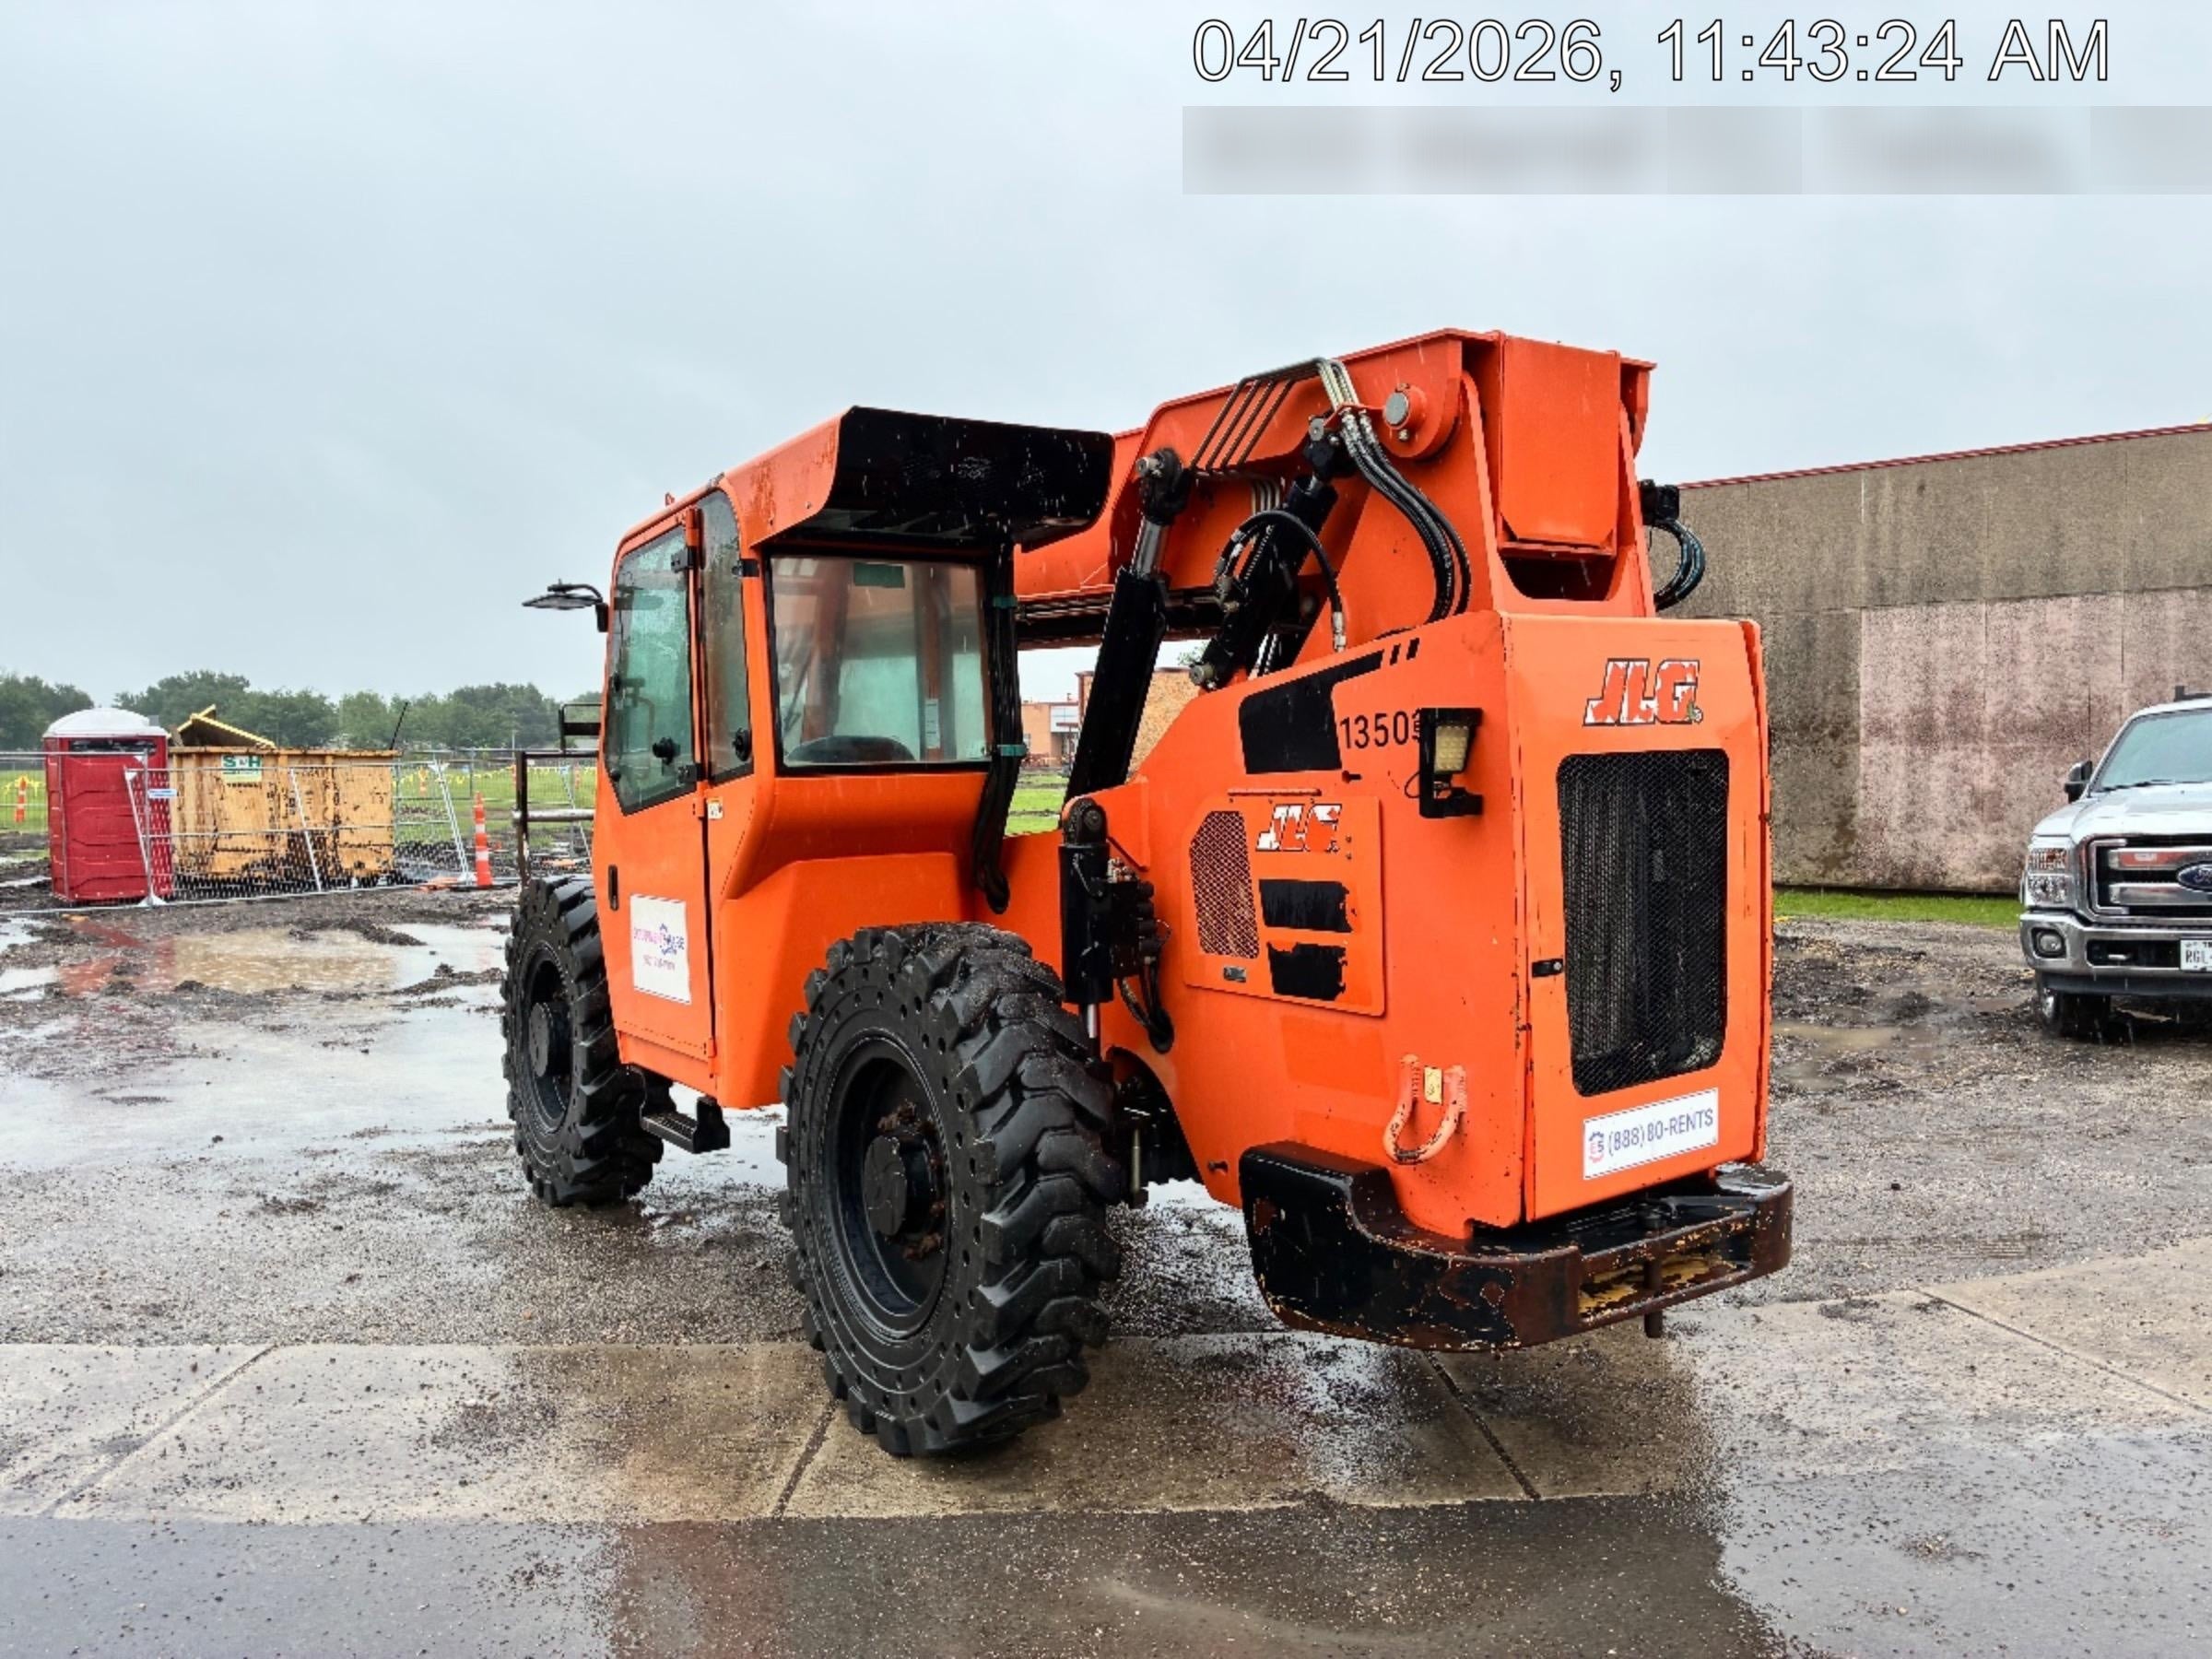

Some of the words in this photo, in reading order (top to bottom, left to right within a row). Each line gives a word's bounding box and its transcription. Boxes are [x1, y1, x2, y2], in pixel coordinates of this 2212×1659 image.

[1583, 657, 1700, 727] JLG
[1608, 1124, 1645, 1158] (888)
[1647, 1108, 1714, 1143] 80-RENTS
